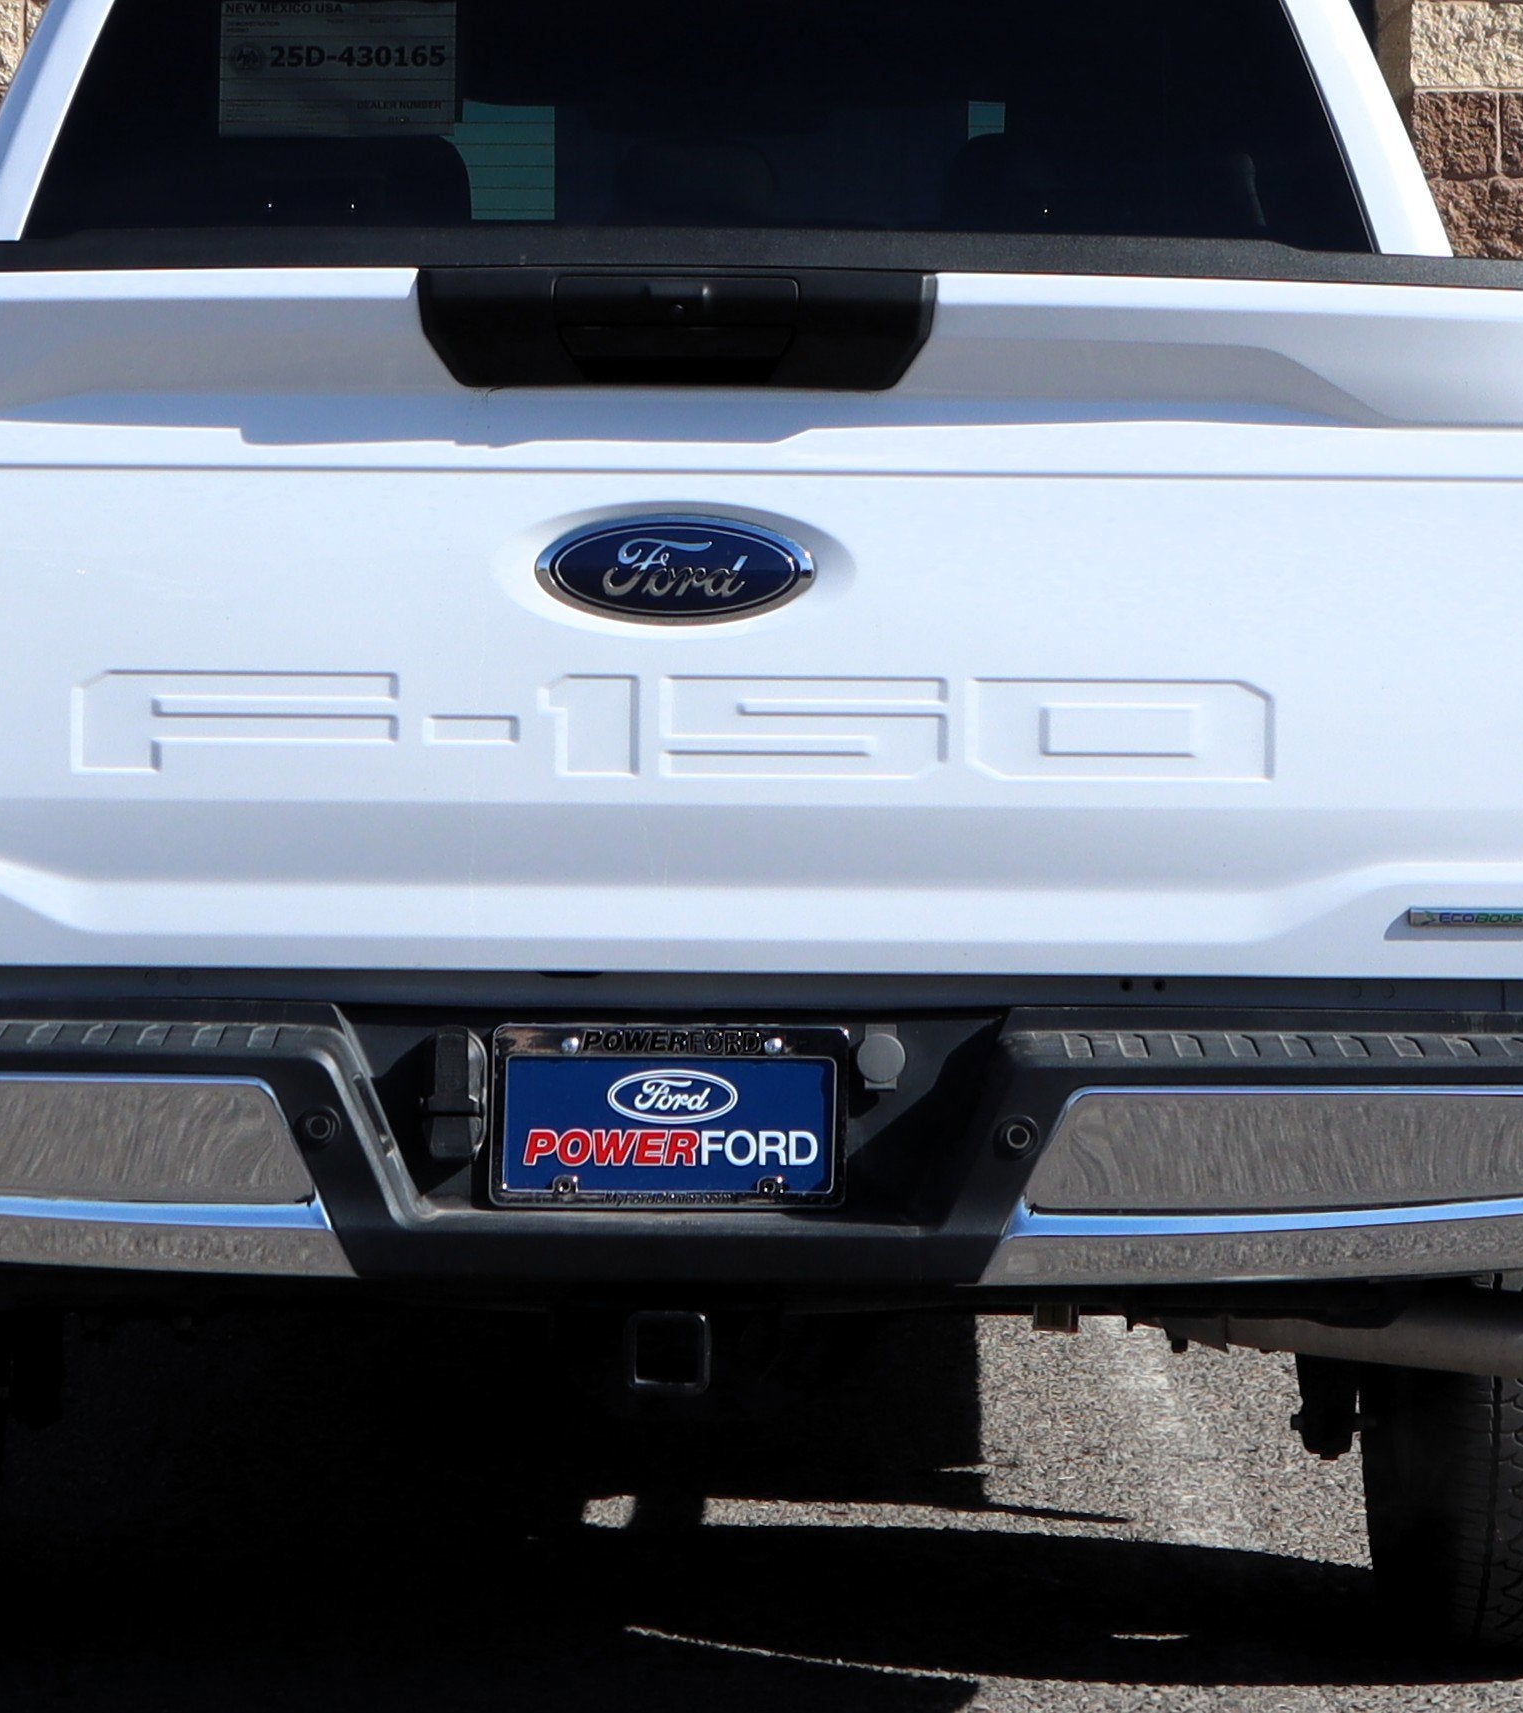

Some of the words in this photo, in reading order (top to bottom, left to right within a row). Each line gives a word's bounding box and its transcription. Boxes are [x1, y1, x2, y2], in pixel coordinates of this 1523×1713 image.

[225, 3, 255, 14] NEW
[260, 3, 312, 14] MEXICO
[316, 2, 343, 13] USA
[269, 45, 446, 68] 25D-430165
[358, 100, 398, 110] DEALER
[399, 100, 442, 110] NUMBER
[601, 537, 749, 598] Ford
[70, 669, 1276, 781] F-150
[633, 1077, 710, 1112] Ford
